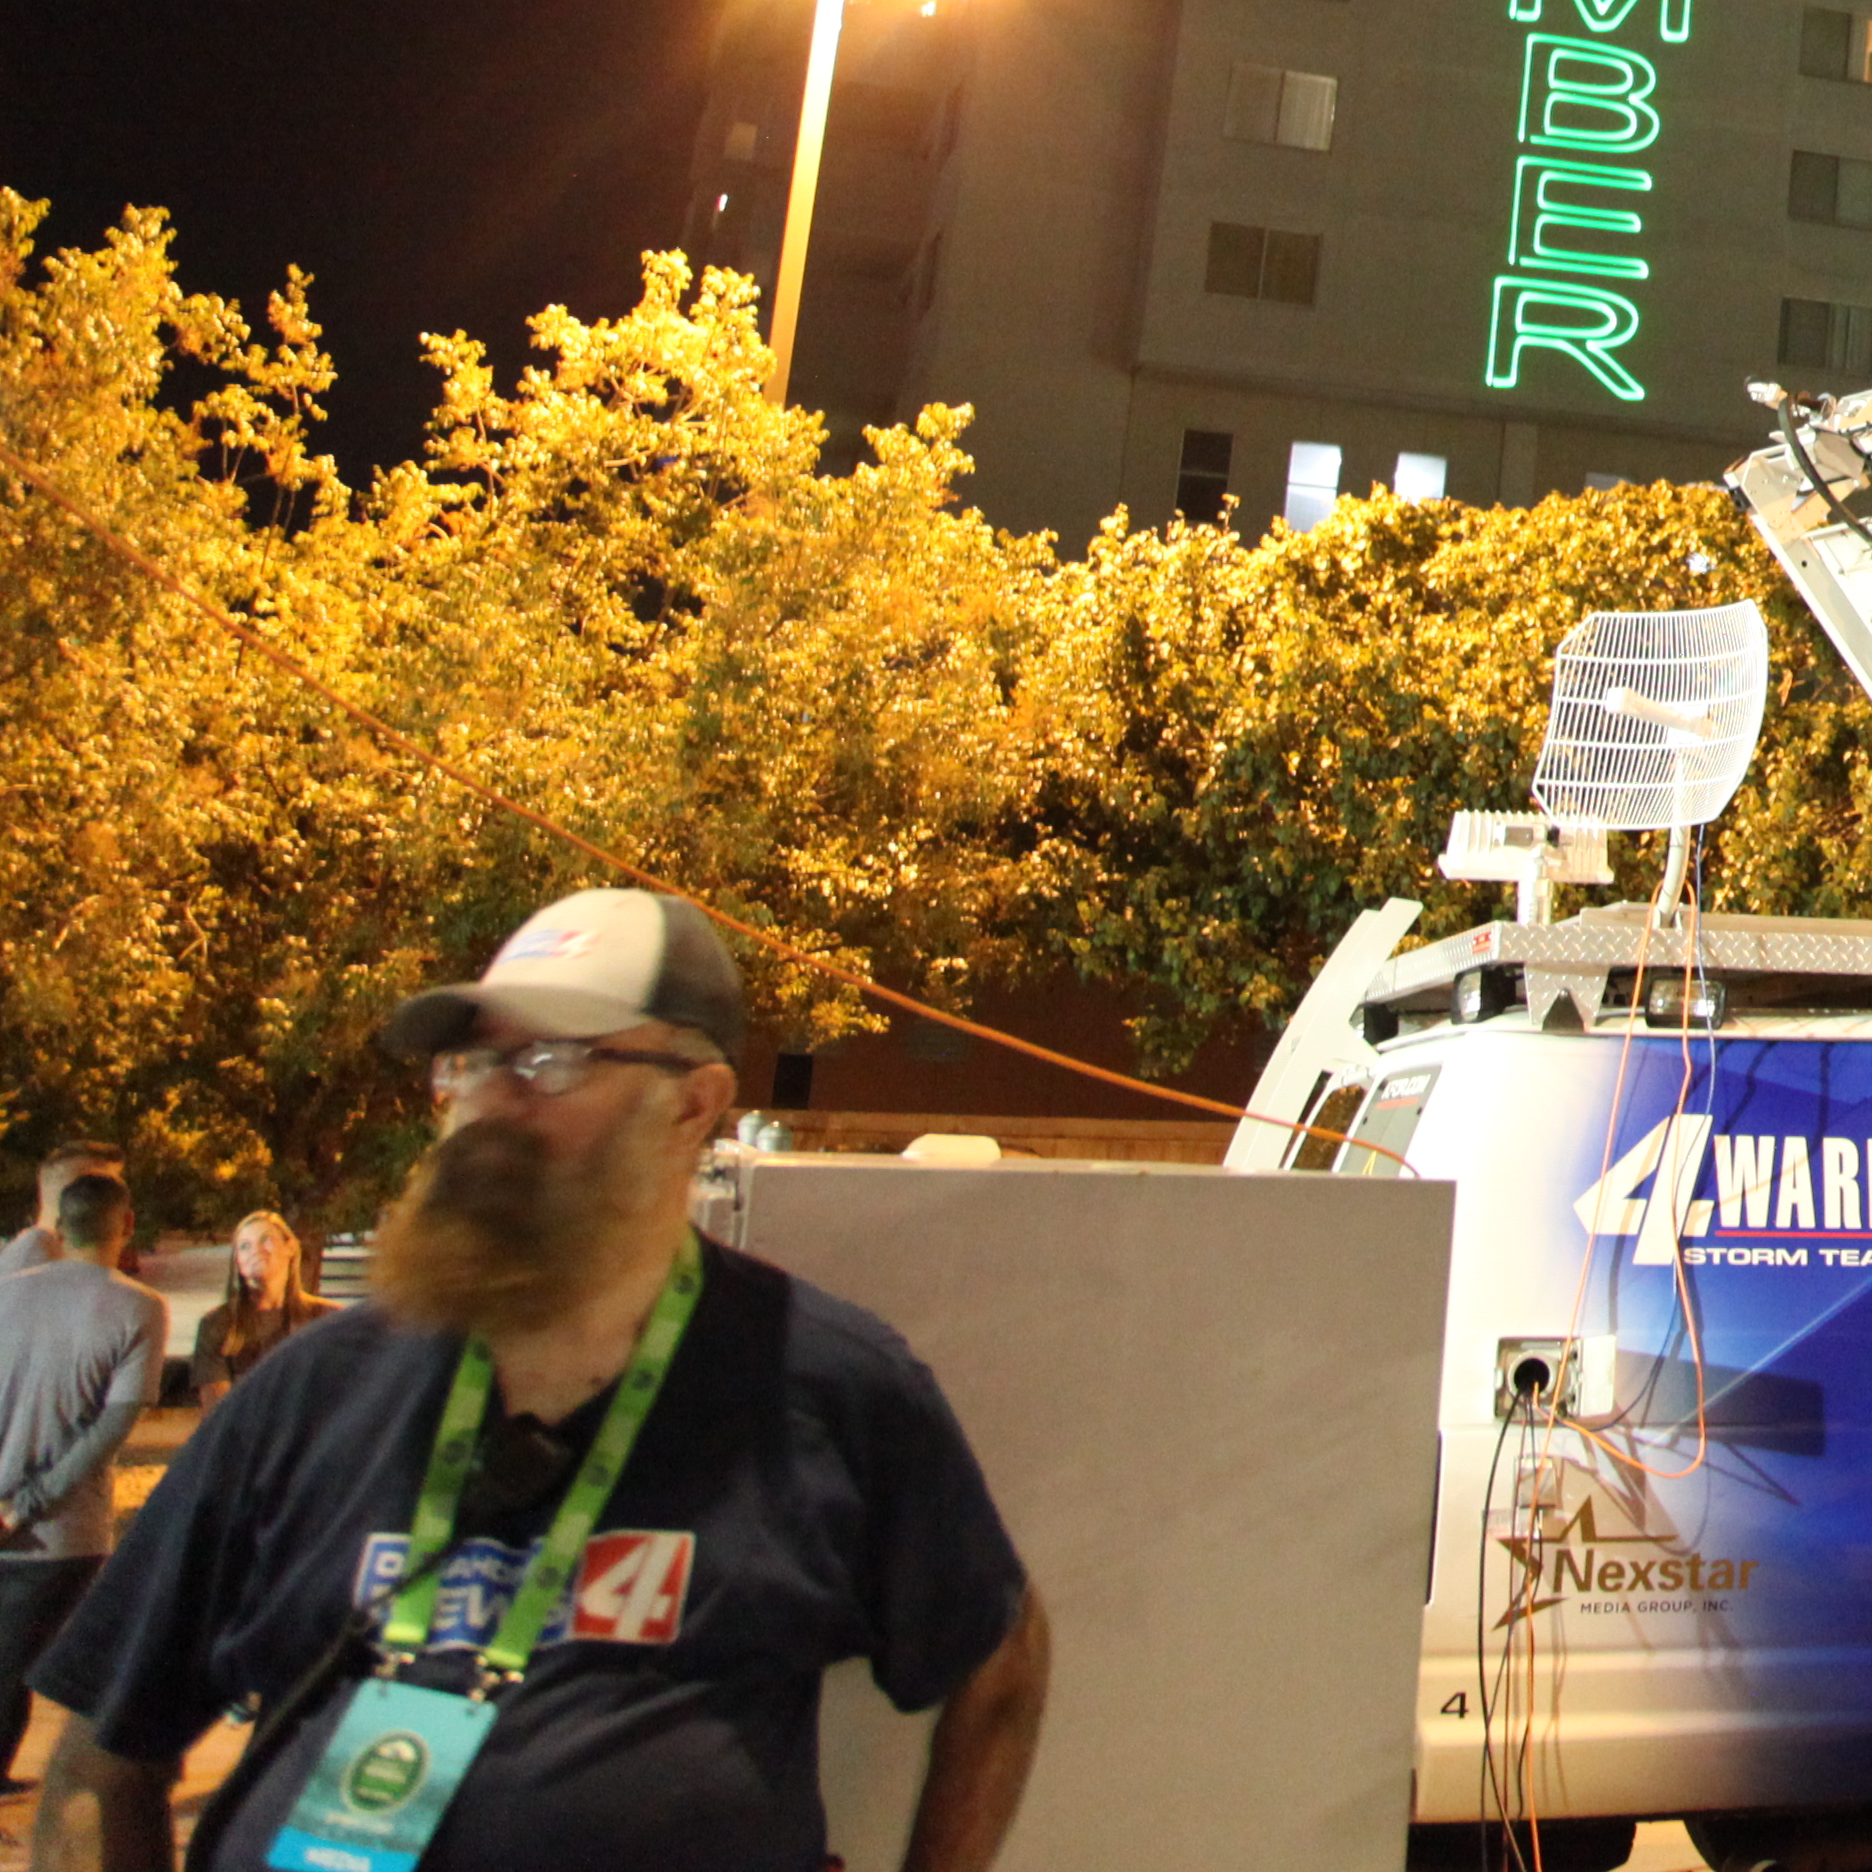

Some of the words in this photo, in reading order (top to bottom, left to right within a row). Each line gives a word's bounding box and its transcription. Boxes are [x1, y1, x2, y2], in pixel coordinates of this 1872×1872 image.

[1683, 1247, 1808, 1266] STORM
[1553, 1547, 1759, 1593] Nexstar
[580, 1533, 683, 1641] 4
[1580, 1601, 1631, 1614] MEDIA
[1637, 1600, 1697, 1614] GROUP,
[1702, 1599, 1734, 1613] INC.
[1440, 1691, 1469, 1719] 4
